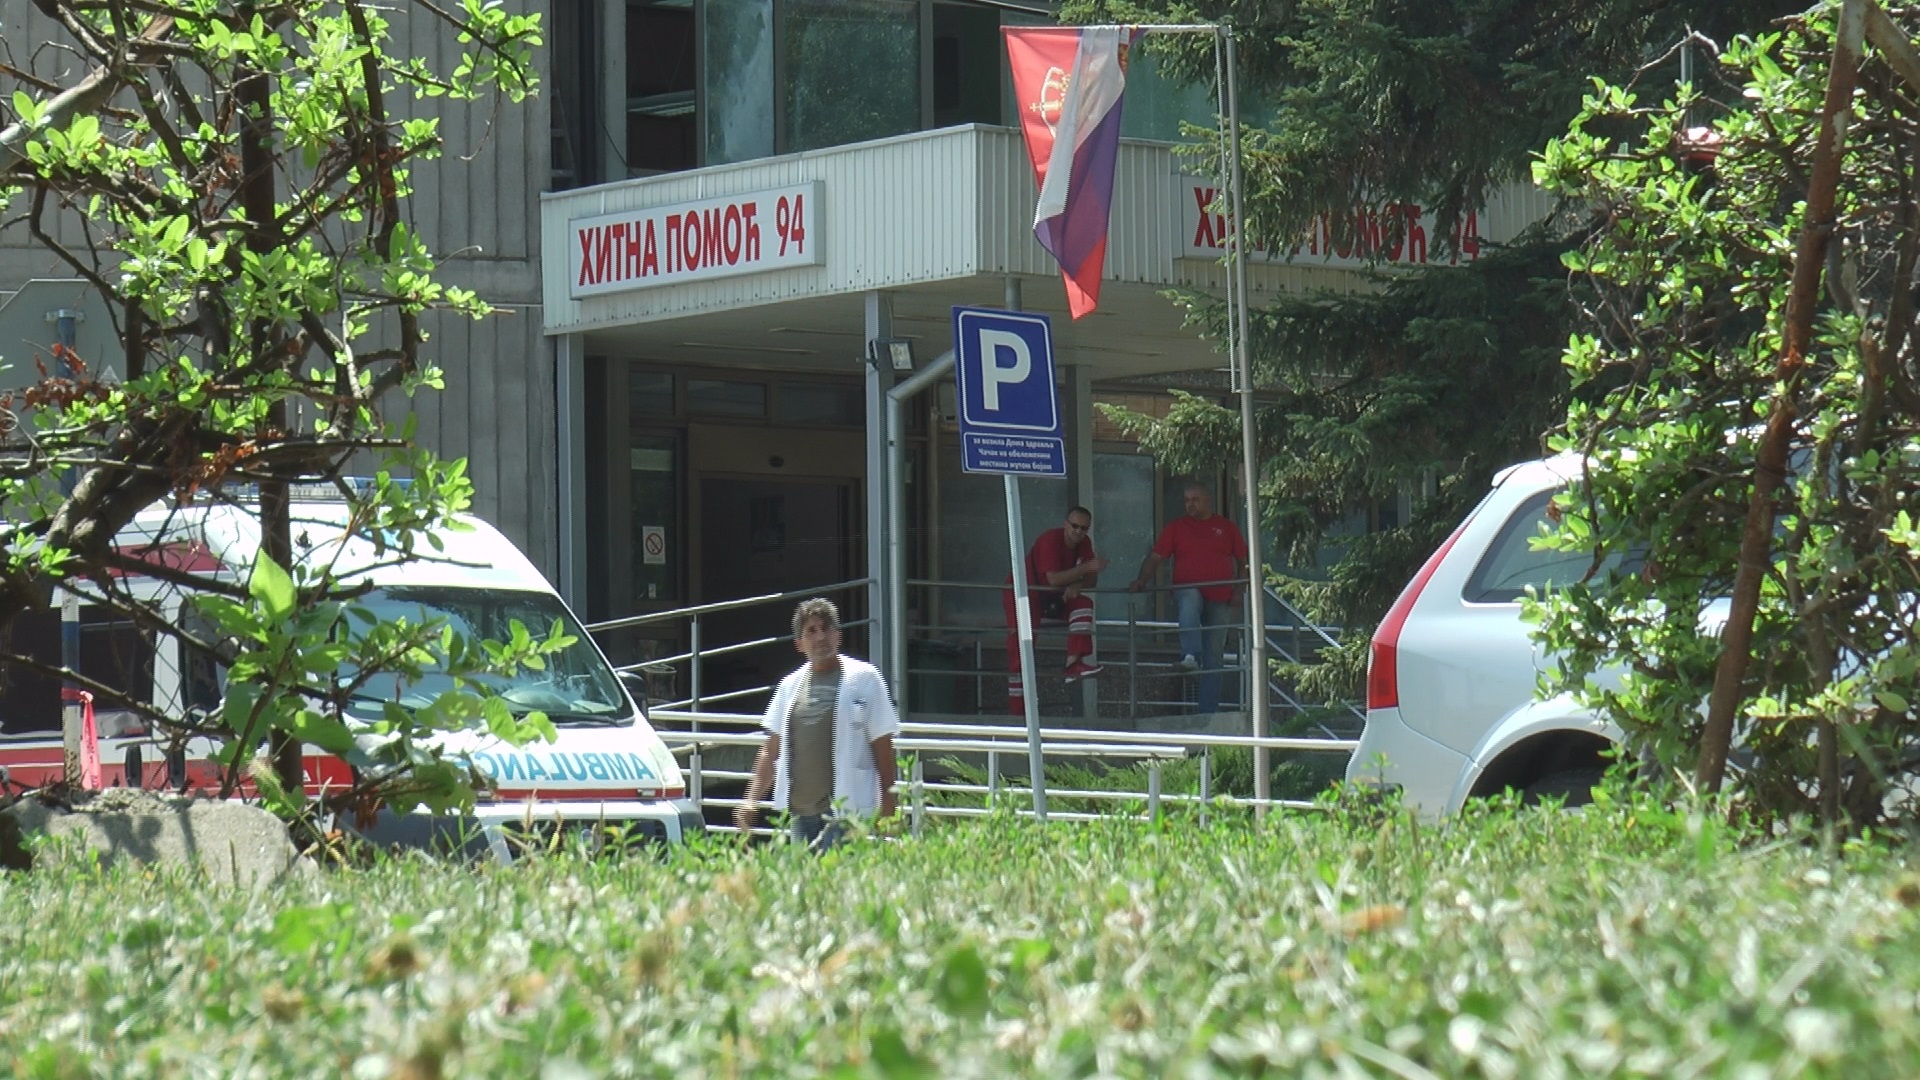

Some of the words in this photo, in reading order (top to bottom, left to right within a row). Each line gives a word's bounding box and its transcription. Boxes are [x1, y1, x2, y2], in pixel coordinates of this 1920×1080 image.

[578, 218, 659, 286] ХИТНА
[665, 202, 761, 273] ПОМОЋ
[775, 194, 806, 257] 94
[979, 328, 1031, 411] P
[978, 448, 998, 456] Чачак
[982, 438, 1005, 446] возила
[1006, 439, 1024, 447] Дома
